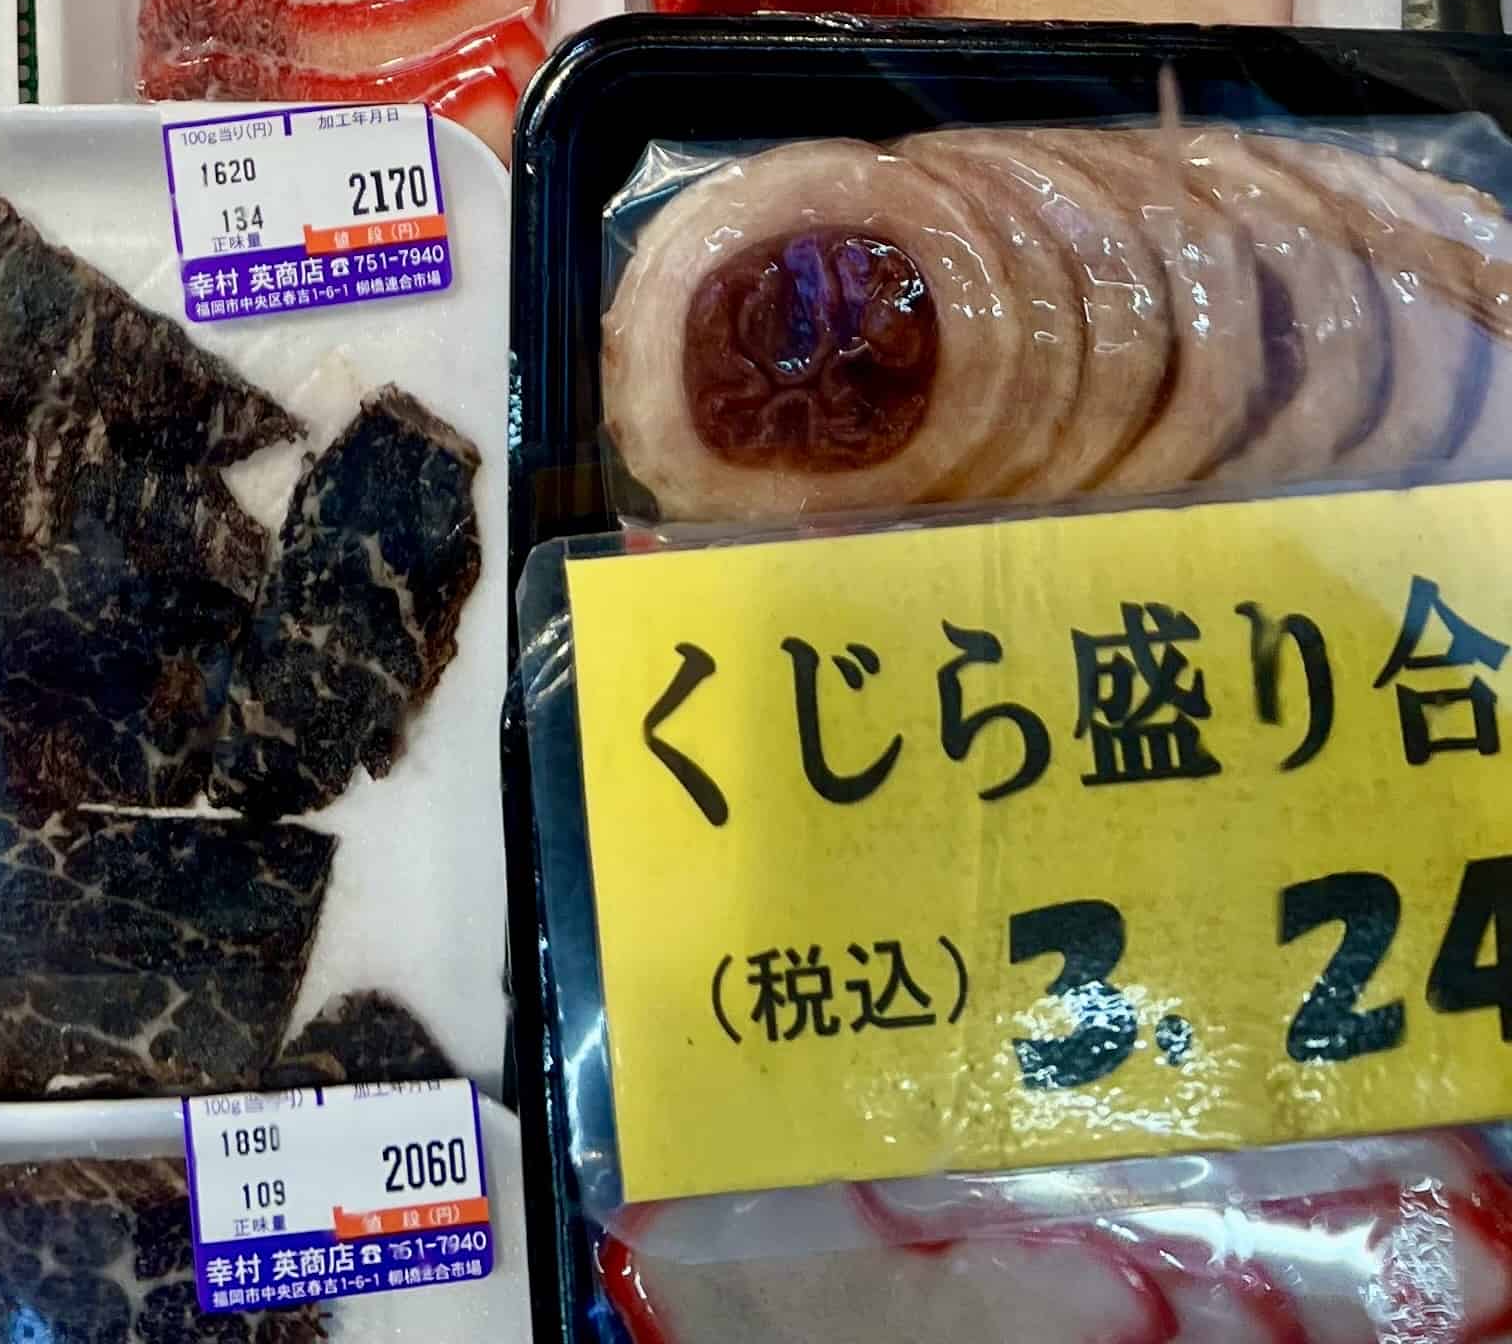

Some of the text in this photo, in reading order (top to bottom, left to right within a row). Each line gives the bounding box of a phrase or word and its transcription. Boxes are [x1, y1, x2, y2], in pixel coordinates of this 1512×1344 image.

[182, 122, 274, 146] 100g当り(円)
[318, 107, 400, 130] 加工年月日
[200, 157, 256, 187] 1620
[349, 164, 428, 216] 2170
[222, 204, 264, 234] 134
[212, 232, 262, 252] 正味量
[190, 244, 444, 298] 幸村 英商店 751-7940
[195, 285, 349, 317] 福岡市中央区春吉1-6-1
[643, 572, 1512, 828] くじら盛り合
[709, 933, 972, 1045] (税込)
[221, 1124, 281, 1157] 1890
[382, 1137, 467, 1192] 2060
[242, 1180, 286, 1209] 109
[233, 1214, 287, 1238] 正味量
[207, 1253, 262, 1287] 幸村
[272, 1243, 355, 1281] 英商店
